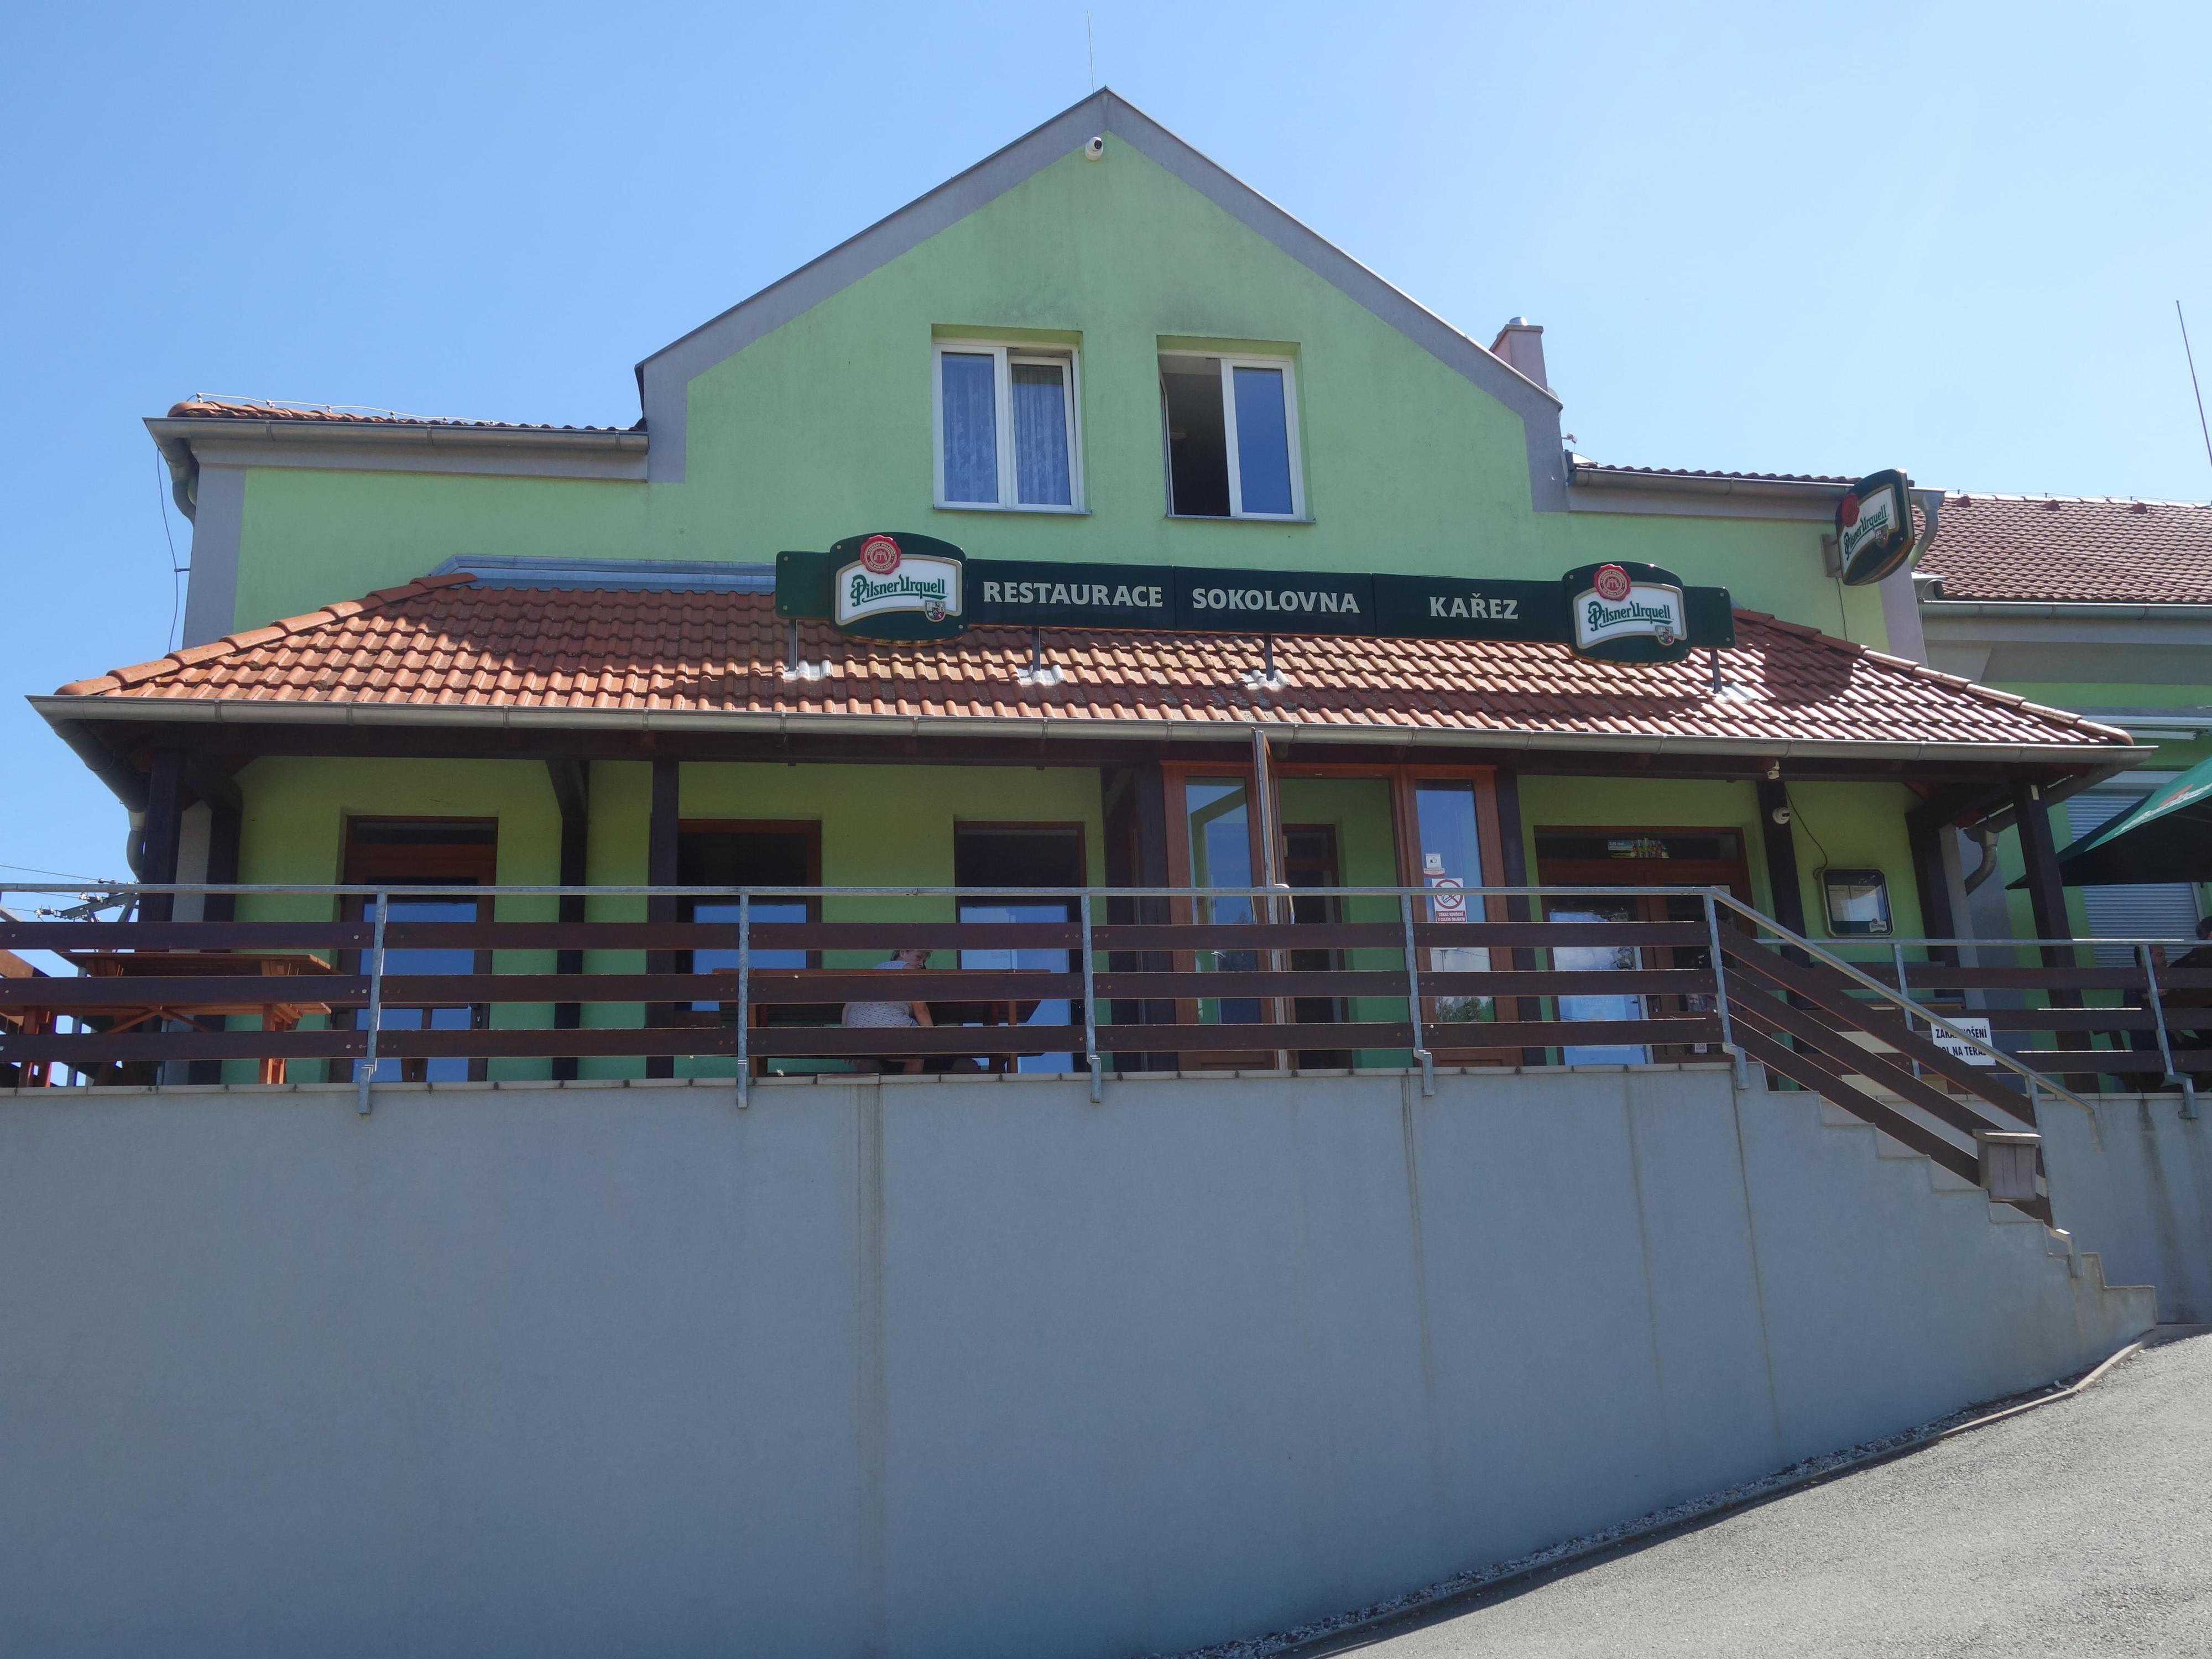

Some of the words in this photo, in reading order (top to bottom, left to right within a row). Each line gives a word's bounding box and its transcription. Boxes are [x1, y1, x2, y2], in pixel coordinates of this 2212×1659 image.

[850, 574, 900, 607] Pilsner
[899, 574, 945, 599] Urquell
[983, 581, 1163, 607] RESTAURACE
[1192, 588, 1360, 613] SOKOLOVNA
[1429, 593, 1519, 620] KAŘEZ
[1588, 601, 1631, 632] Pilsner
[1630, 601, 1671, 624] Urquell
[1953, 1046, 1963, 1056] NA
